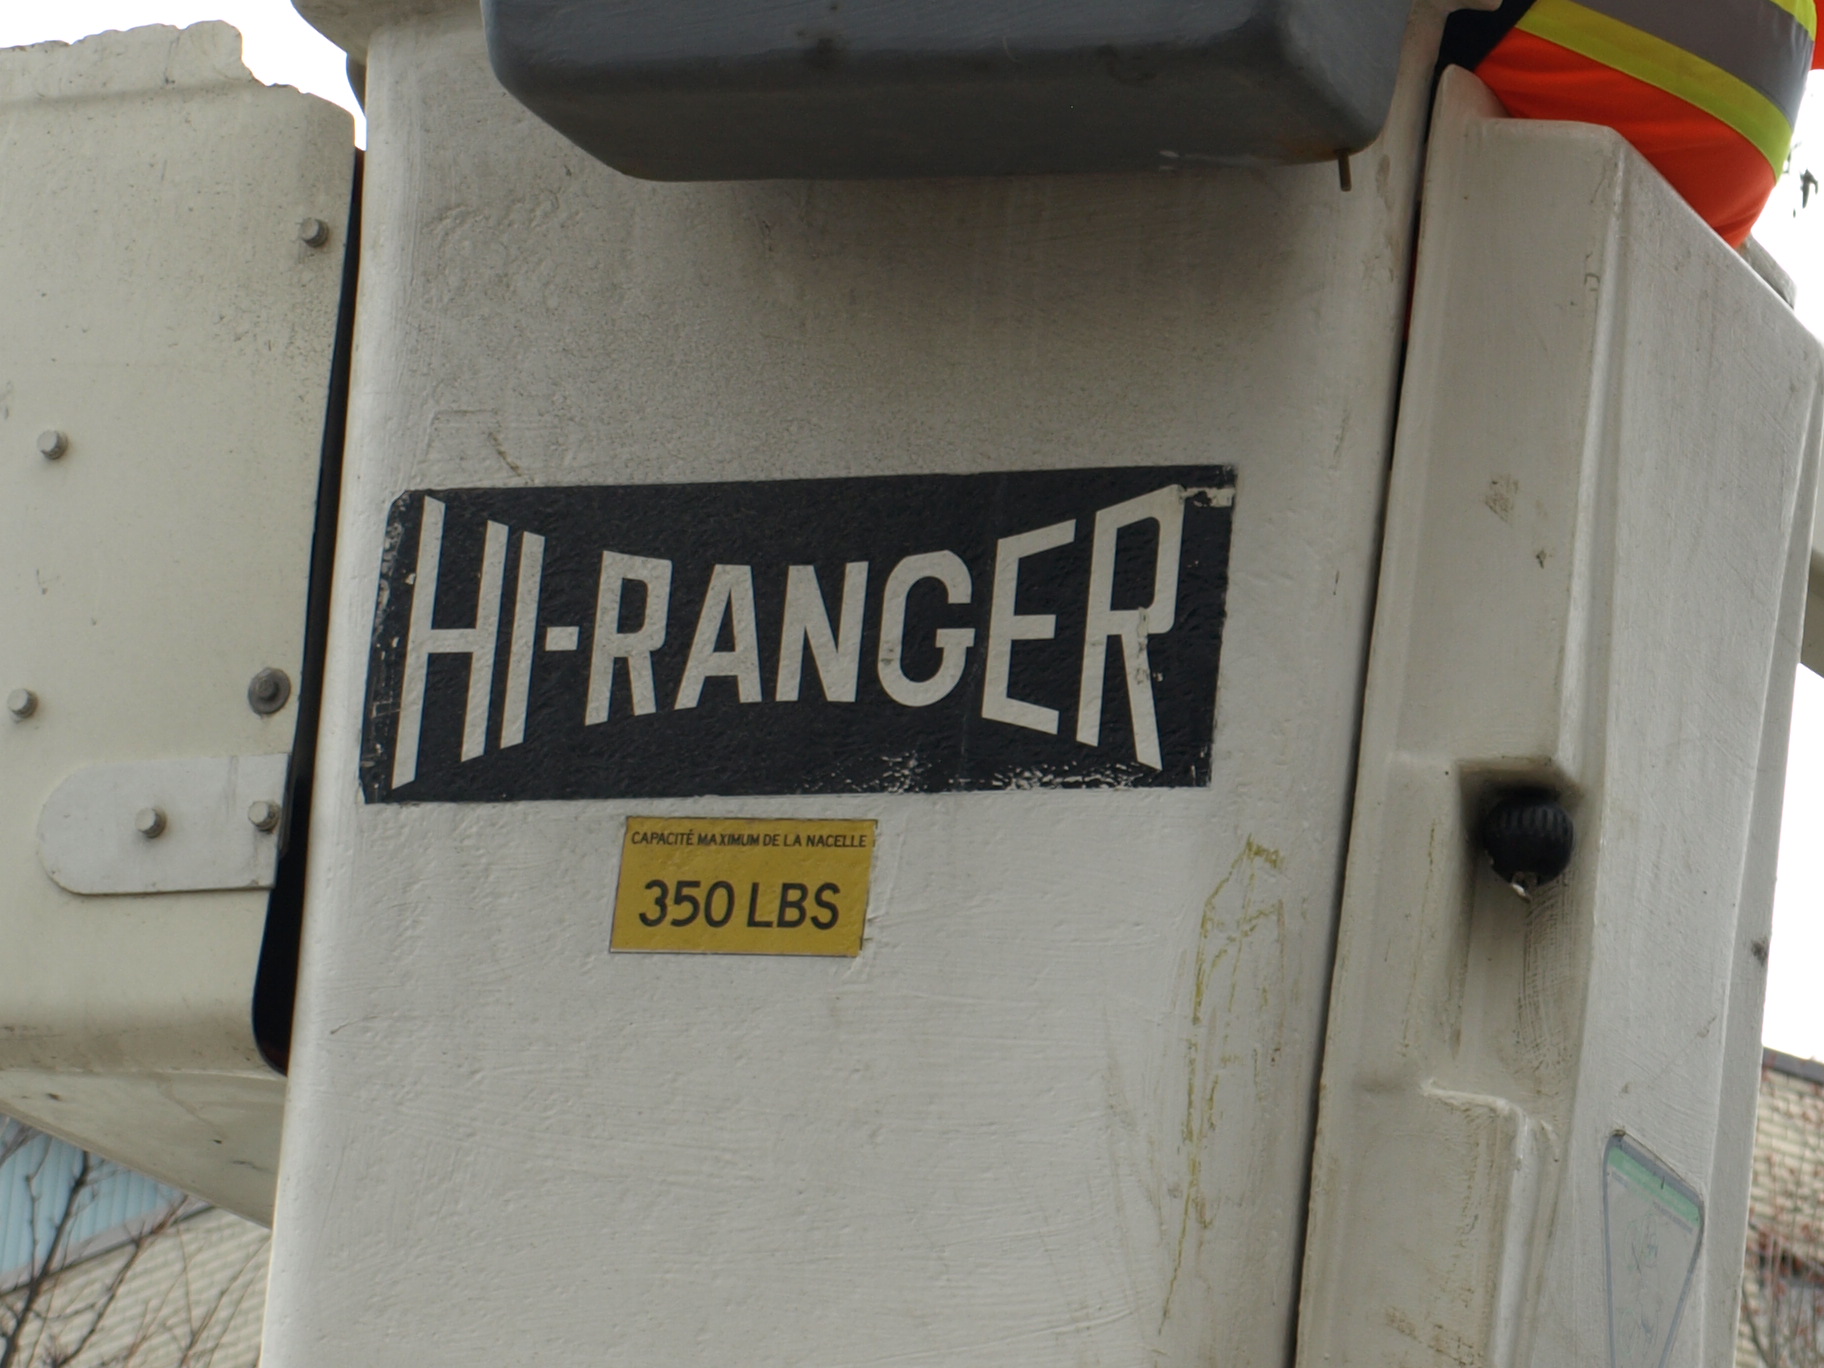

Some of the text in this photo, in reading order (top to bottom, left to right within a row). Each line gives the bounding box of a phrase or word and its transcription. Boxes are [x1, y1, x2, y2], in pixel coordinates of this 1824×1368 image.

[392, 484, 1187, 790] HI-RANGER
[631, 829, 867, 848] CAPACITÉ MAXIMUM DE LA NACELLE
[639, 880, 840, 930] 350 LBS
